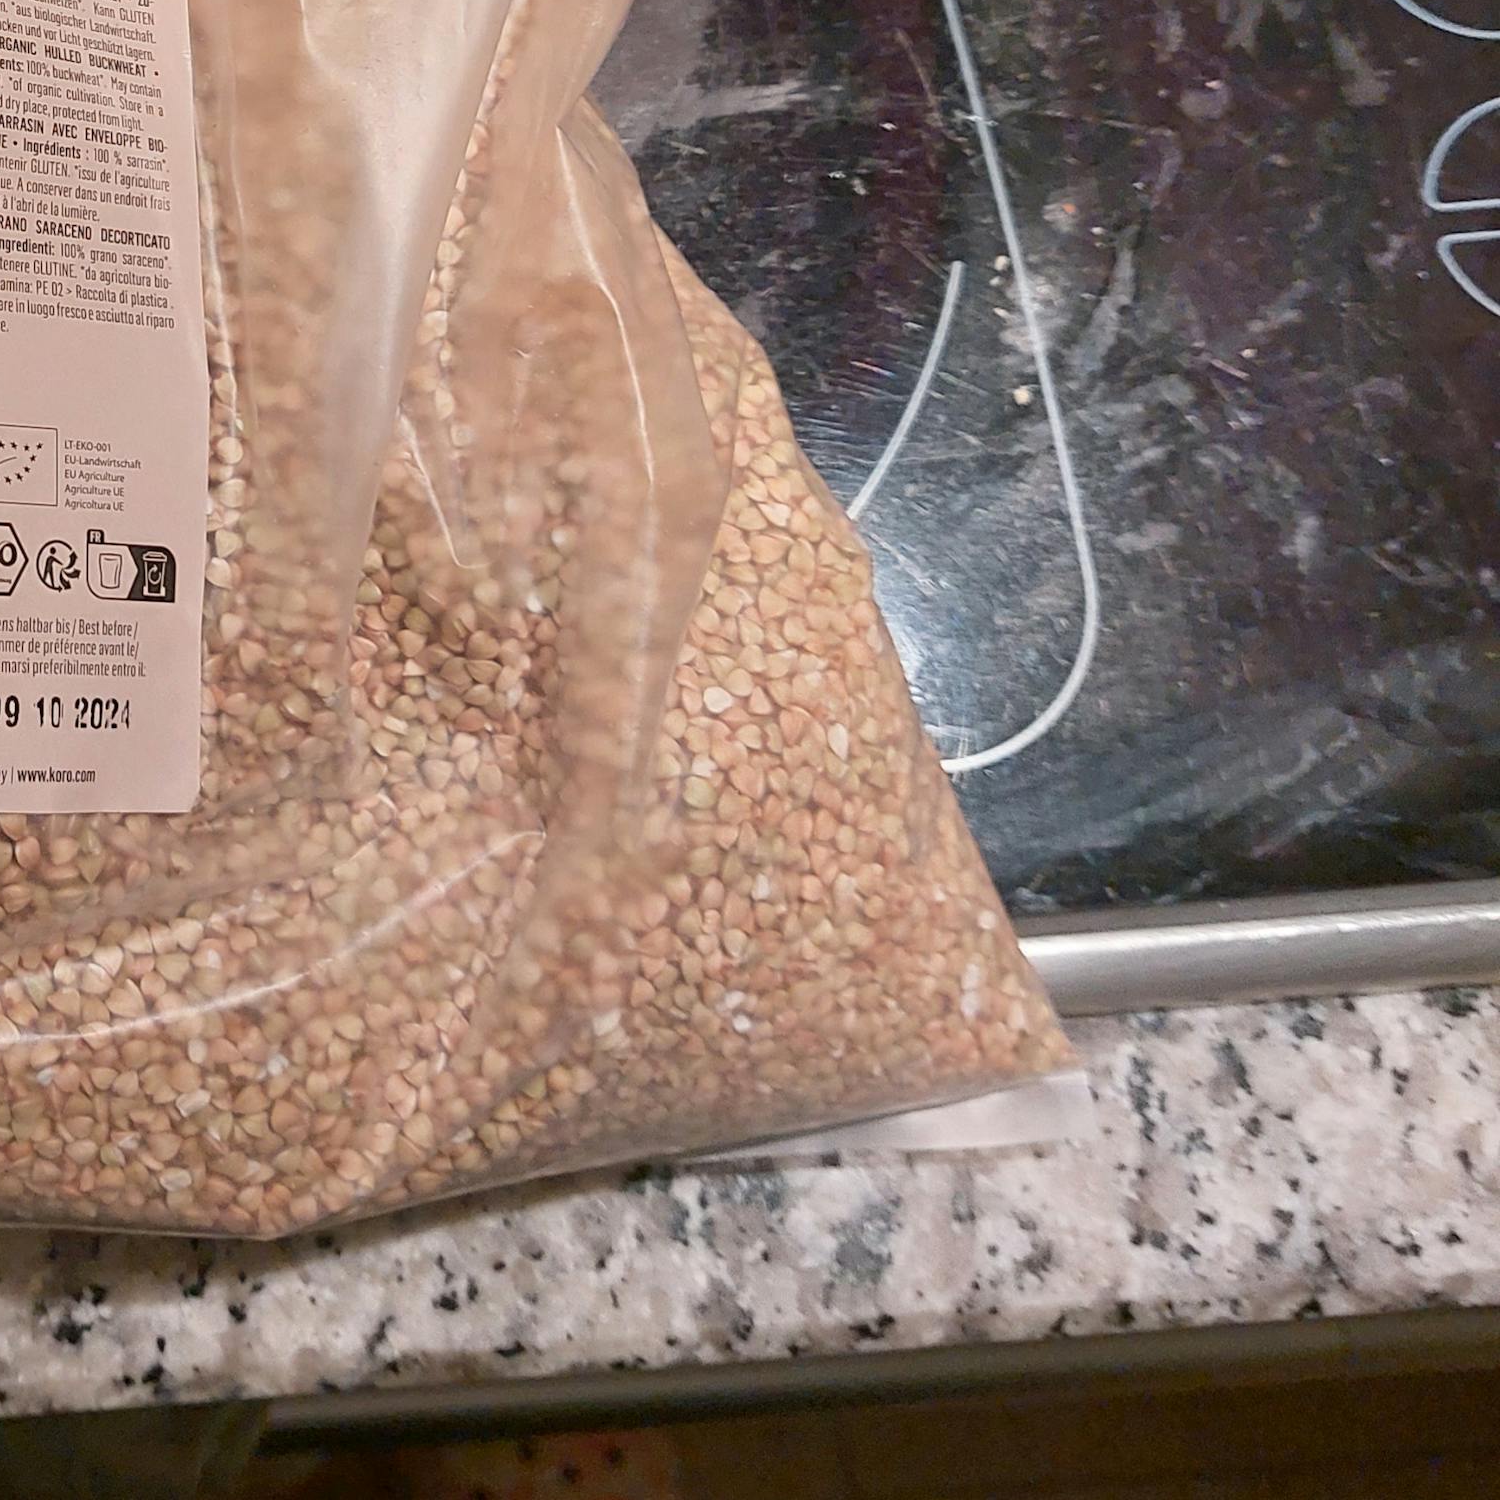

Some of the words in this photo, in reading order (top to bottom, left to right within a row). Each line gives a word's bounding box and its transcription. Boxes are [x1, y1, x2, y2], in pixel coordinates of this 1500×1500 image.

[45, 45, 81, 64] HULLED
[89, 54, 146, 77] BUCKWHEAT
[28, 80, 62, 98] organic
[52, 122, 77, 139] AVEC
[85, 127, 141, 149] ENVELOPPE
[24, 138, 81, 158] Ingrédients
[94, 148, 109, 163] 100
[26, 182, 72, 198] conserver
[115, 193, 148, 208] endroit
[36, 220, 92, 240] SARACENO
[101, 228, 170, 250] DECORTICATO
[90, 249, 117, 263] grano
[100, 268, 151, 287] agricoltura
[27, 300, 54, 318] luogo
[65, 440, 111, 452] LT-EKO-001
[65, 455, 141, 469] EU-Landwirtschaft
[65, 470, 76, 479] EU
[78, 471, 124, 484] Agriculture
[65, 484, 111, 497] Agriculture
[113, 488, 124, 497] UE
[65, 499, 111, 512] Agricoltura
[113, 502, 124, 511] UE
[16, 616, 53, 634] haltbar
[56, 619, 70, 634] bis
[79, 620, 100, 635] Best
[43, 638, 96, 656] préférence
[99, 643, 124, 656] avant
[33, 658, 109, 677] preferibilmente
[112, 664, 136, 677] entro
[34, 697, 63, 728] 10
